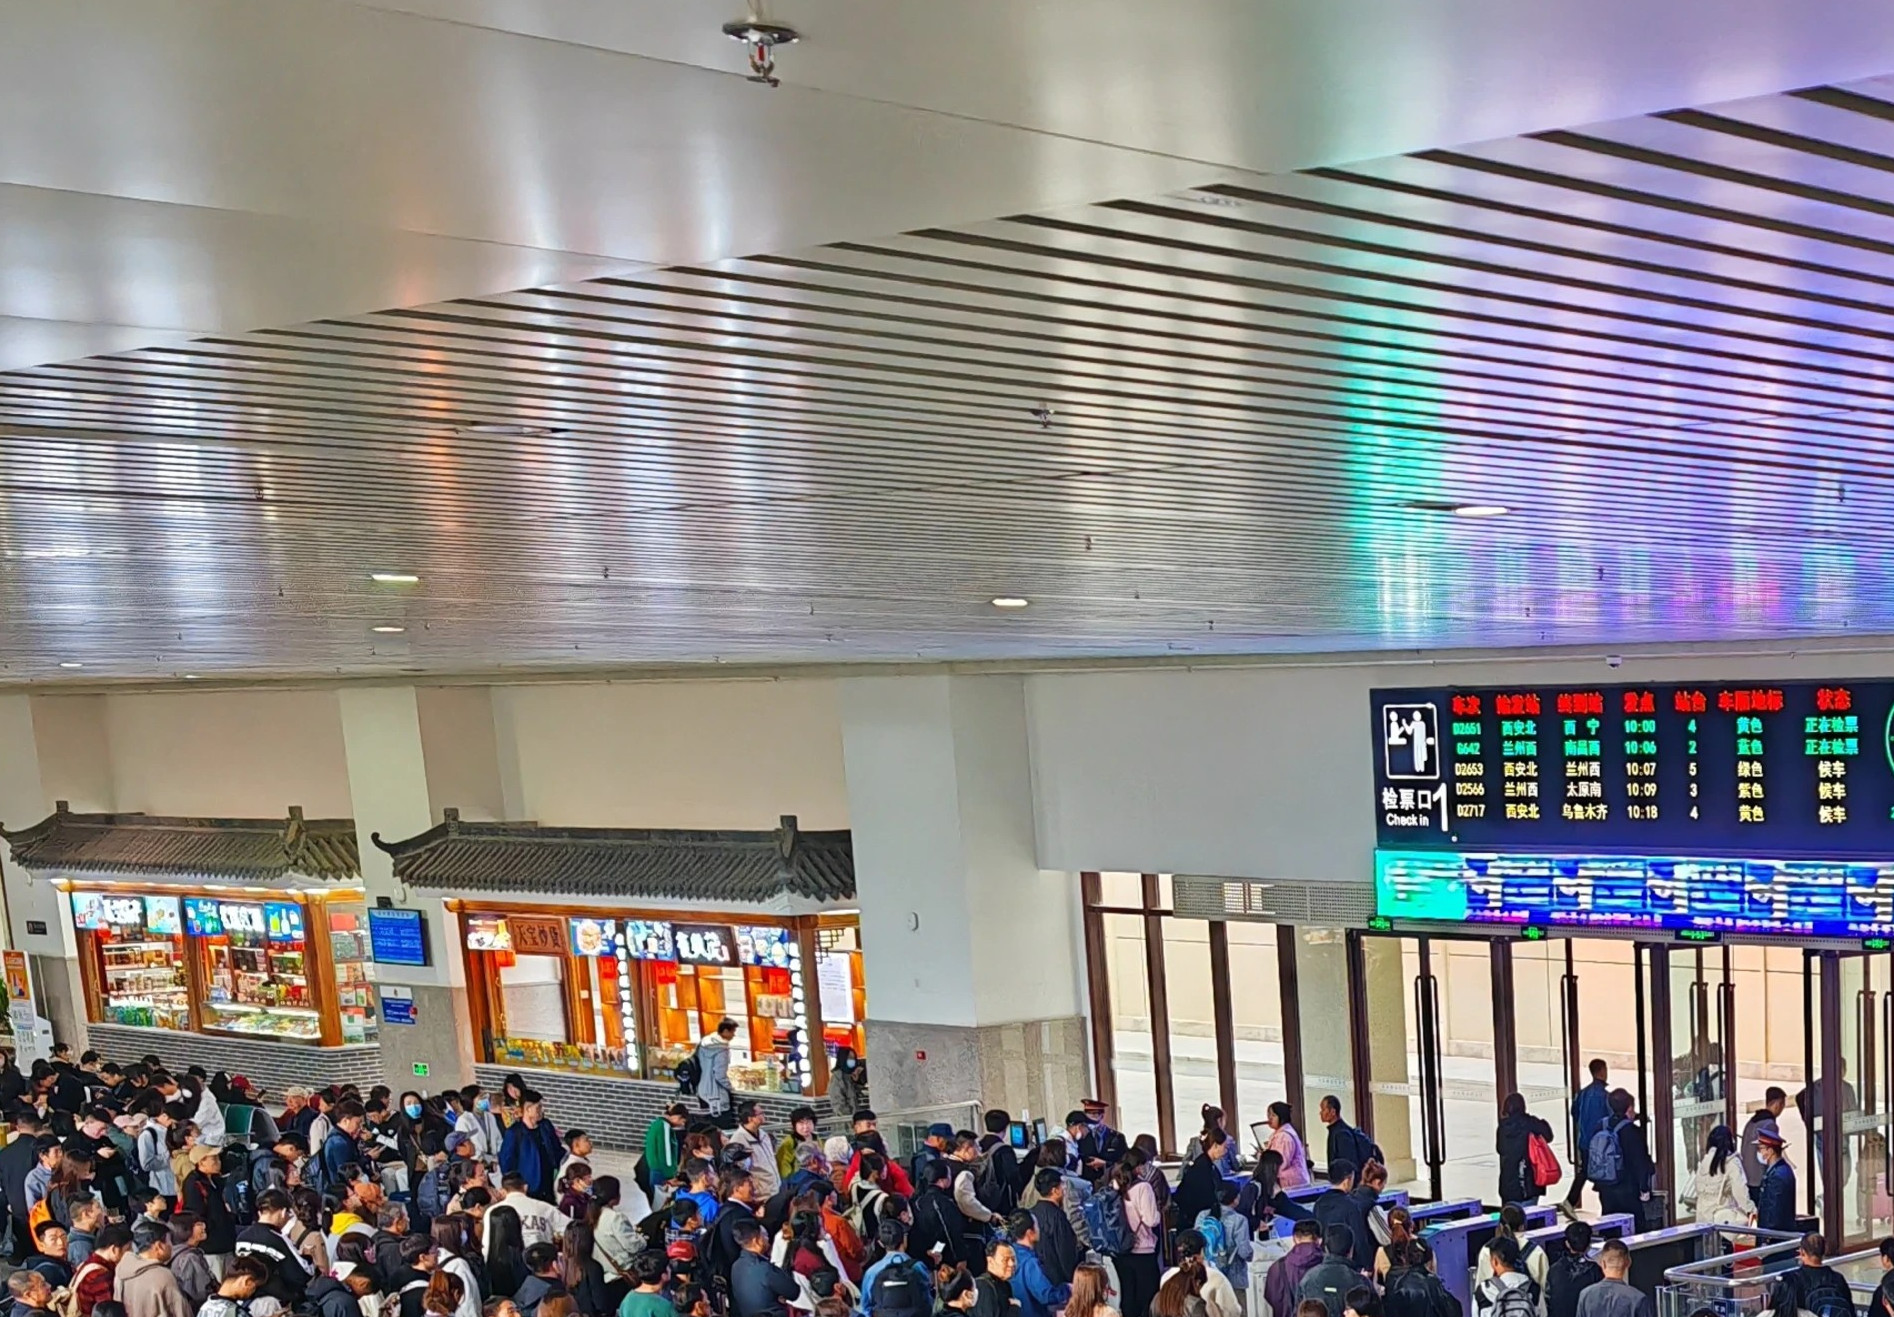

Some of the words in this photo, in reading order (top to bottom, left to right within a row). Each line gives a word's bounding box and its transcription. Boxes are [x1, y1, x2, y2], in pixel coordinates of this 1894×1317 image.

[1452, 721, 1482, 736] D2651
[1501, 720, 1537, 736] 西安北
[1624, 719, 1656, 733] 10:00
[1688, 718, 1697, 733] 4
[1736, 717, 1763, 734] 黄色
[1805, 716, 1858, 734] 正在检票
[1502, 741, 1537, 756] 兰州西
[1624, 741, 1657, 755] 10:06
[1688, 741, 1697, 754] 2
[1737, 738, 1763, 755] 蓝色
[1805, 738, 1859, 755] 正在检票
[1455, 762, 1484, 777] D2653
[1503, 761, 1538, 777] 西安北
[1565, 761, 1601, 777] 兰州西
[1626, 762, 1657, 777] 10:07
[1689, 762, 1697, 776] 5
[1737, 761, 1764, 778] 绿色
[1818, 761, 1846, 778] 候车
[1382, 787, 1432, 810] 检票口
[1456, 782, 1485, 797] D2566
[1504, 781, 1538, 797] 兰州西
[1566, 781, 1602, 797] 太原南
[1626, 783, 1657, 797] 10:09
[1689, 783, 1698, 798] 3
[1738, 782, 1764, 799] 紫色
[1818, 782, 1846, 800] 候车
[1432, 782, 1448, 832] 1
[1456, 804, 1486, 818] D2717
[1505, 803, 1540, 820] 西安北
[1562, 803, 1608, 820] 乌鲁木齐
[1627, 805, 1658, 820] 10:18
[1689, 806, 1699, 820] 4
[1739, 805, 1765, 822] 黄色
[1818, 805, 1847, 823] 候车
[1386, 813, 1418, 827] Check
[1419, 814, 1430, 827] in
